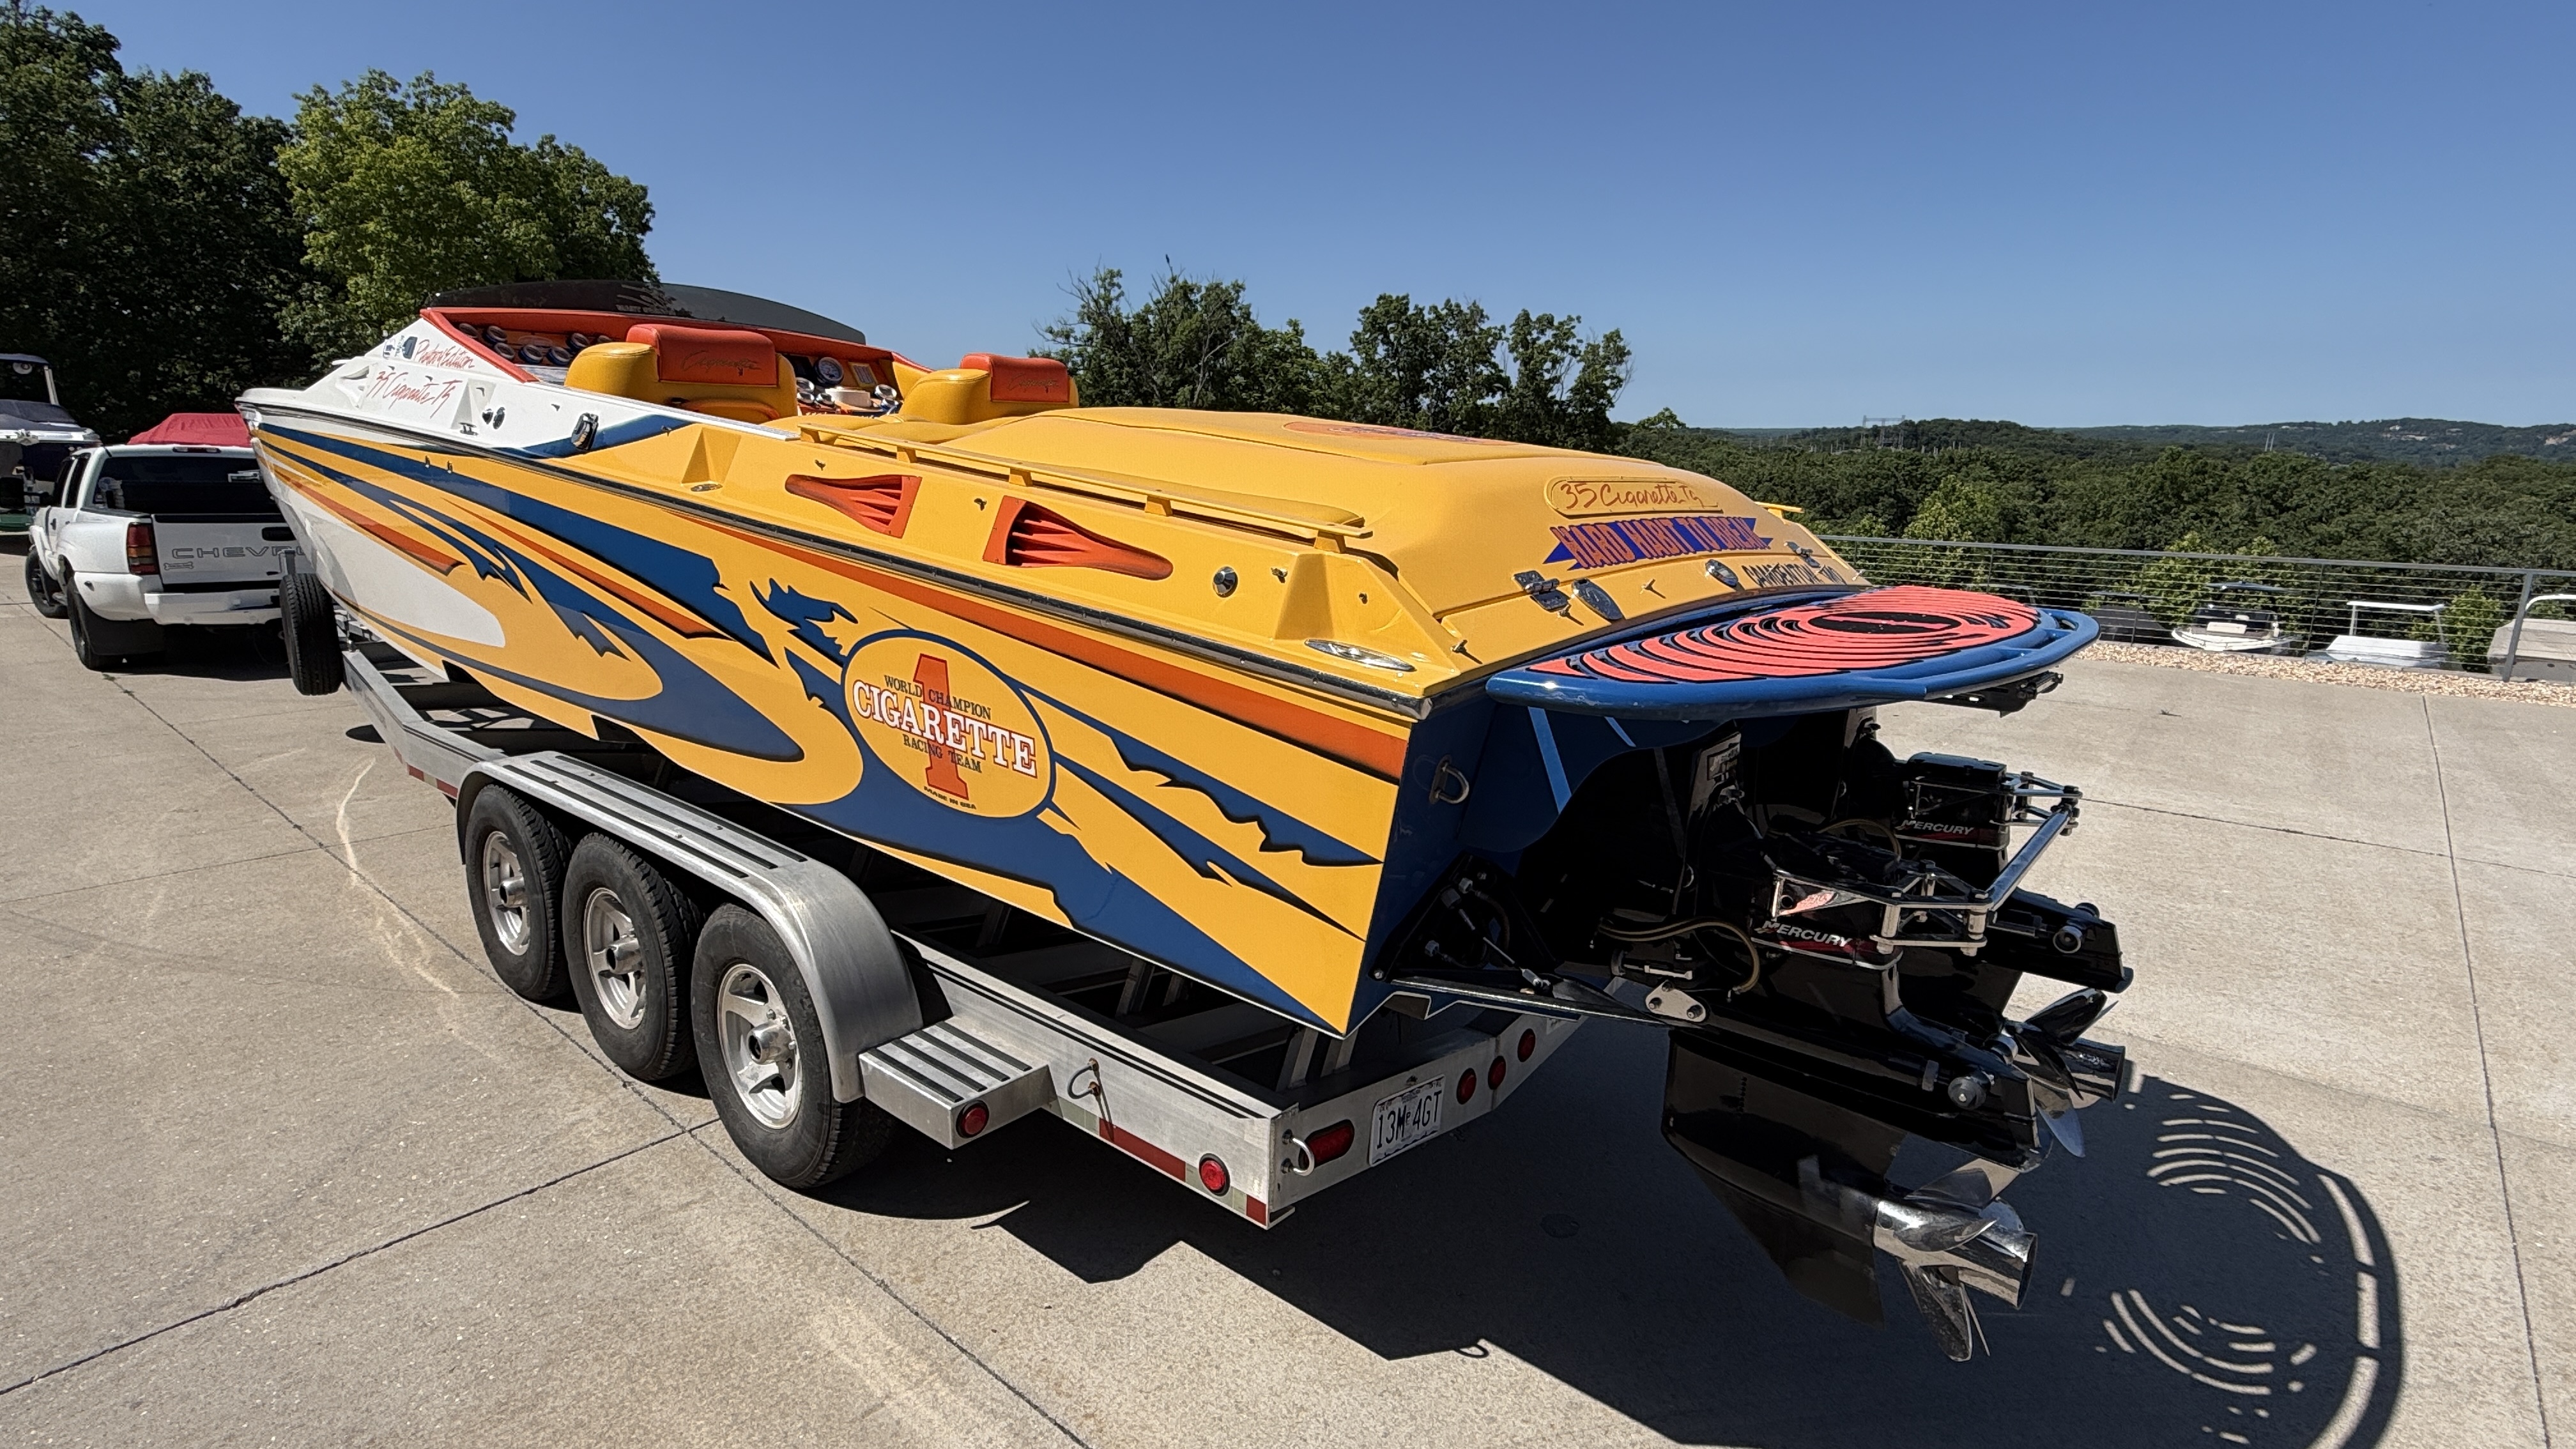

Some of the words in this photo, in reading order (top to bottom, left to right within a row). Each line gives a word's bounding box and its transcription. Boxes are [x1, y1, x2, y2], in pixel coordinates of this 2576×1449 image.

[1560, 482, 1598, 509] 35
[1599, 483, 1685, 508] Cigarette
[1549, 522, 1637, 569] HARD
[1615, 518, 1697, 560] HABIT
[1673, 516, 1722, 552] TO
[1698, 516, 1771, 550] BREAK
[884, 675, 923, 698] WORLD
[928, 688, 992, 720] CHAMPION
[853, 679, 1038, 779] CIGARETTE
[903, 733, 943, 758] RACING
[947, 750, 983, 773] TEAM
[1901, 819, 1974, 835] MERCURY
[1761, 920, 1853, 947] MERCURY
[1412, 1090, 1442, 1130] 4GT
